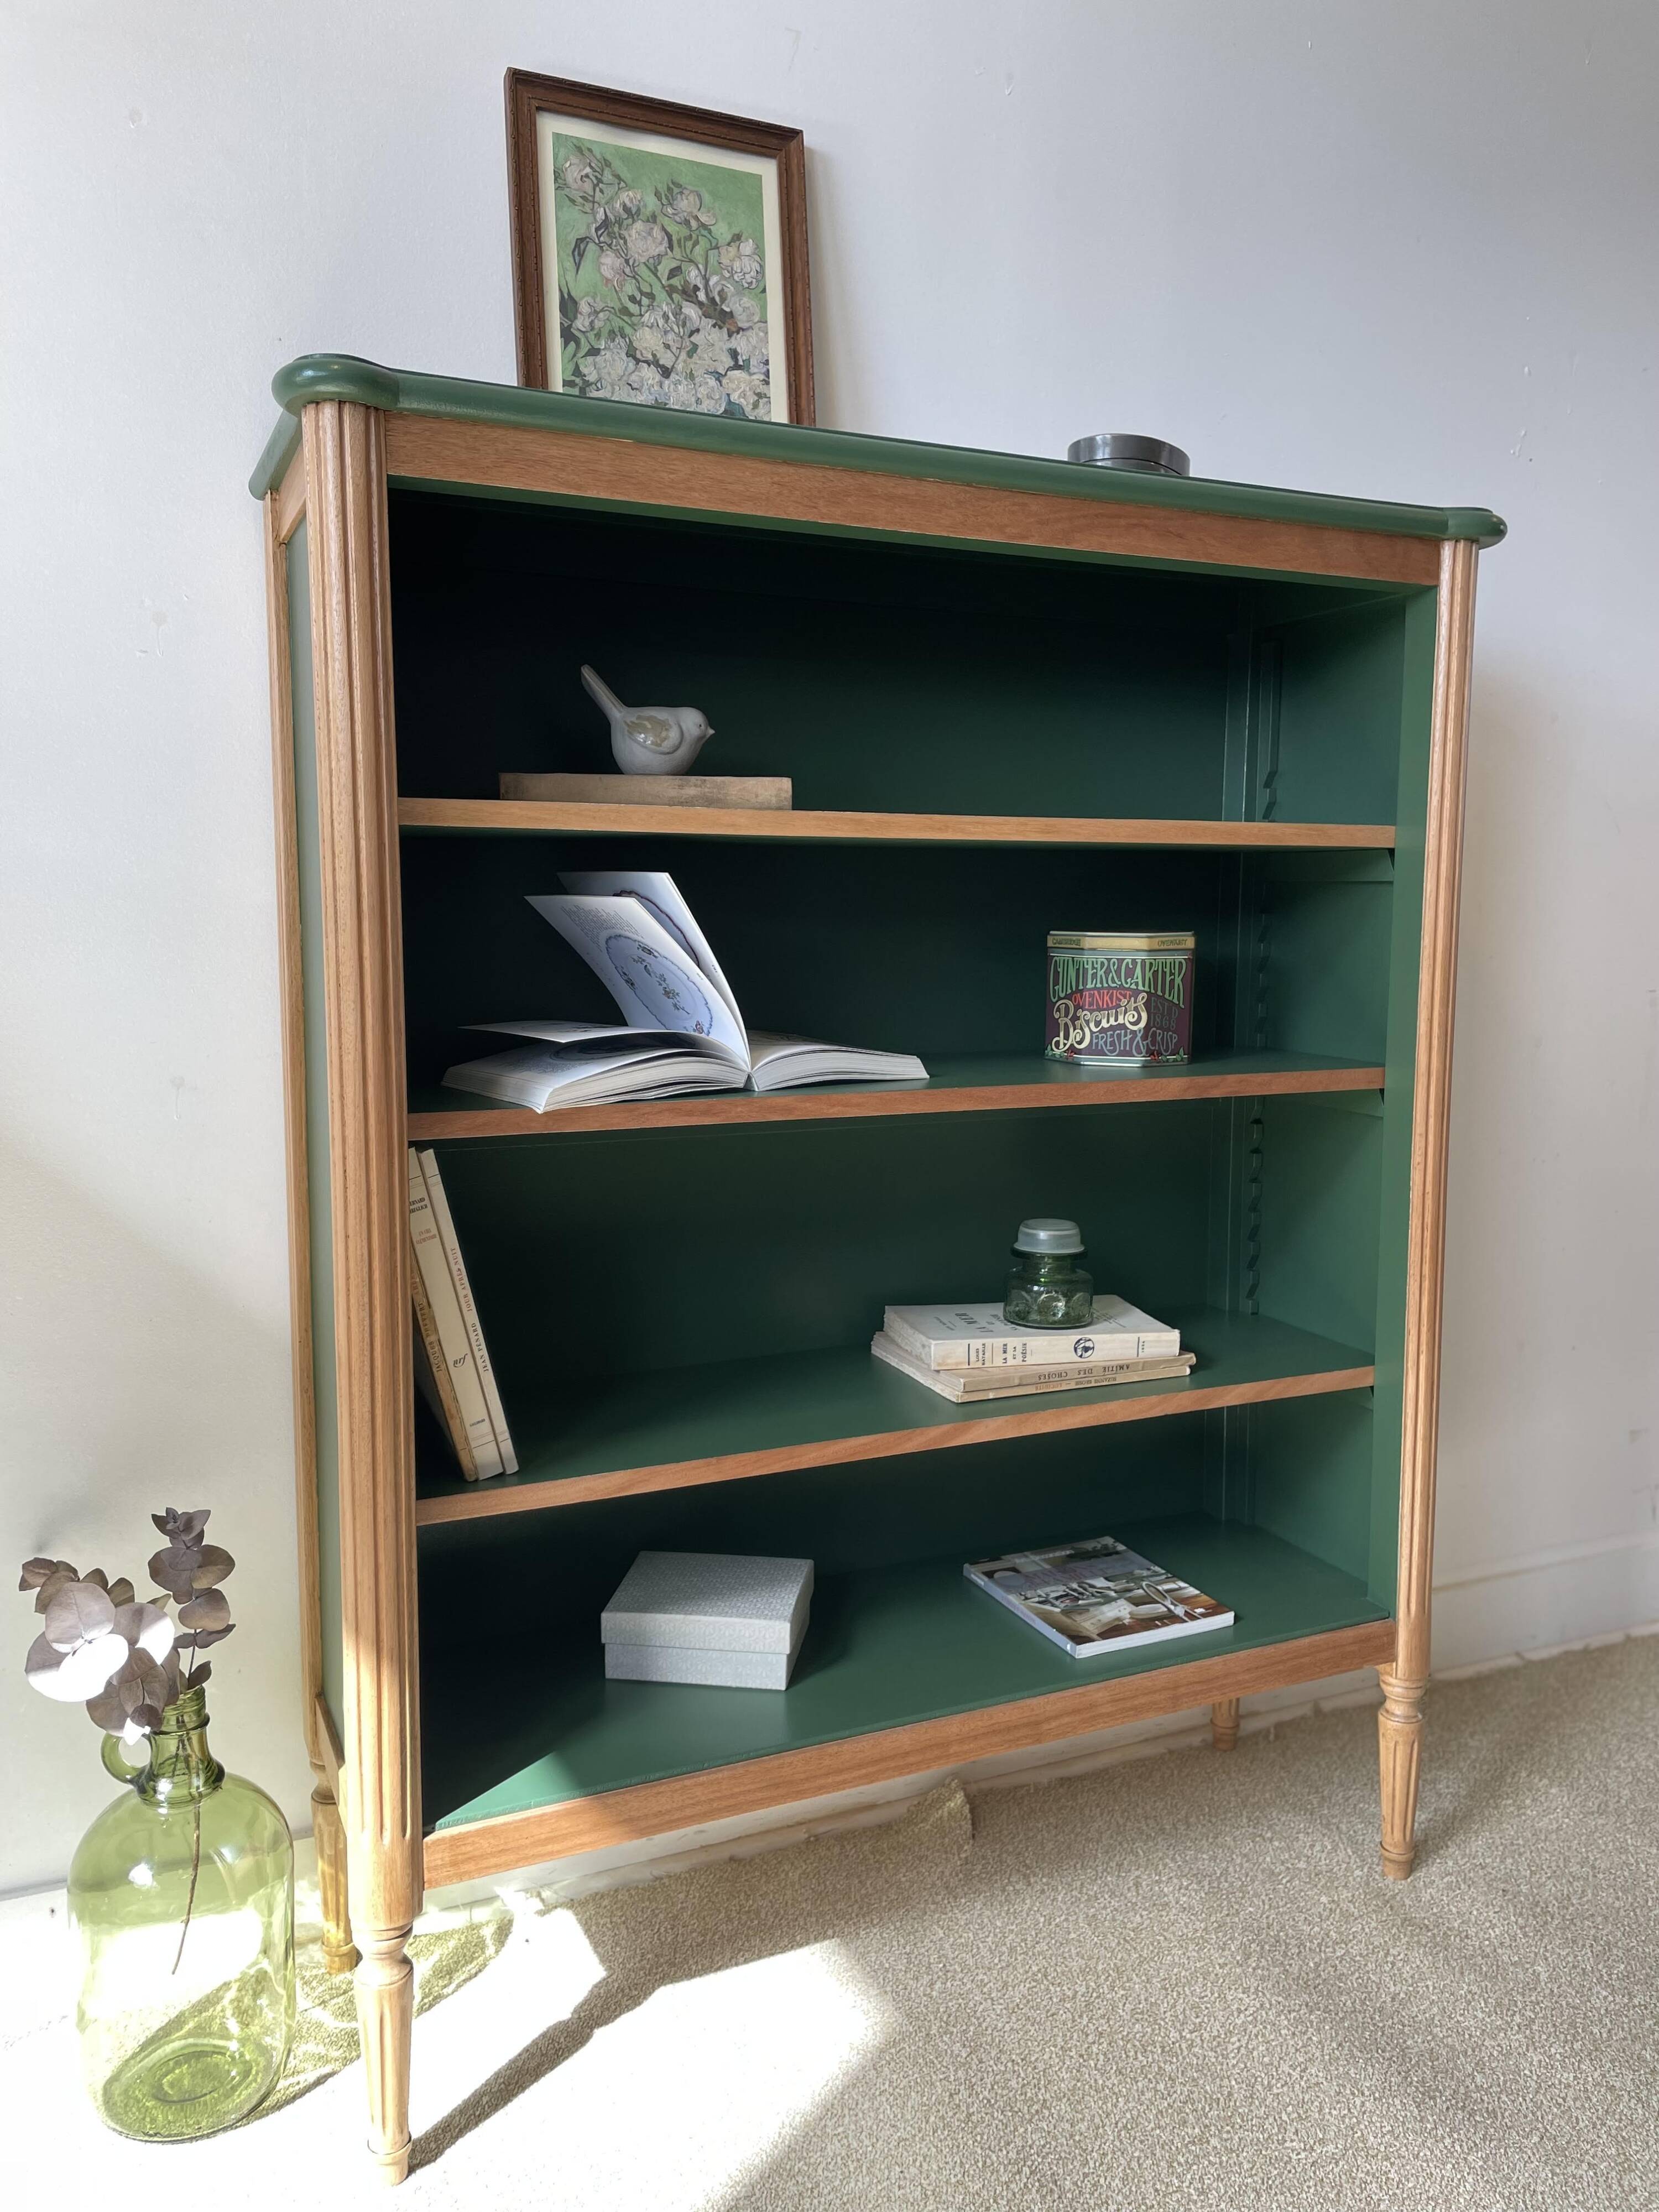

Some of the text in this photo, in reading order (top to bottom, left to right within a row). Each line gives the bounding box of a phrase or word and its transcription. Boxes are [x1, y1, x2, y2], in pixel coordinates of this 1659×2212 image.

[1157, 938, 1188, 947] OVENKIST
[1050, 956, 1108, 1003] GUNTER
[1120, 958, 1186, 1009] CARTER
[1072, 989, 1132, 1009] OVENKIST
[1052, 993, 1148, 1052] Biscuits
[1150, 1014, 1177, 1031] 1868
[1092, 1029, 1133, 1056] FRESH
[1147, 1027, 1178, 1056] CRISP
[451, 1248, 460, 1266] NUIT
[463, 1293, 473, 1312] JOUR
[429, 1341, 442, 1372] JACQUES
[479, 1354, 489, 1372] JEAN
[1038, 1371, 1068, 1381] CHOSES
[1102, 1364, 1130, 1375] AMITIÉ
